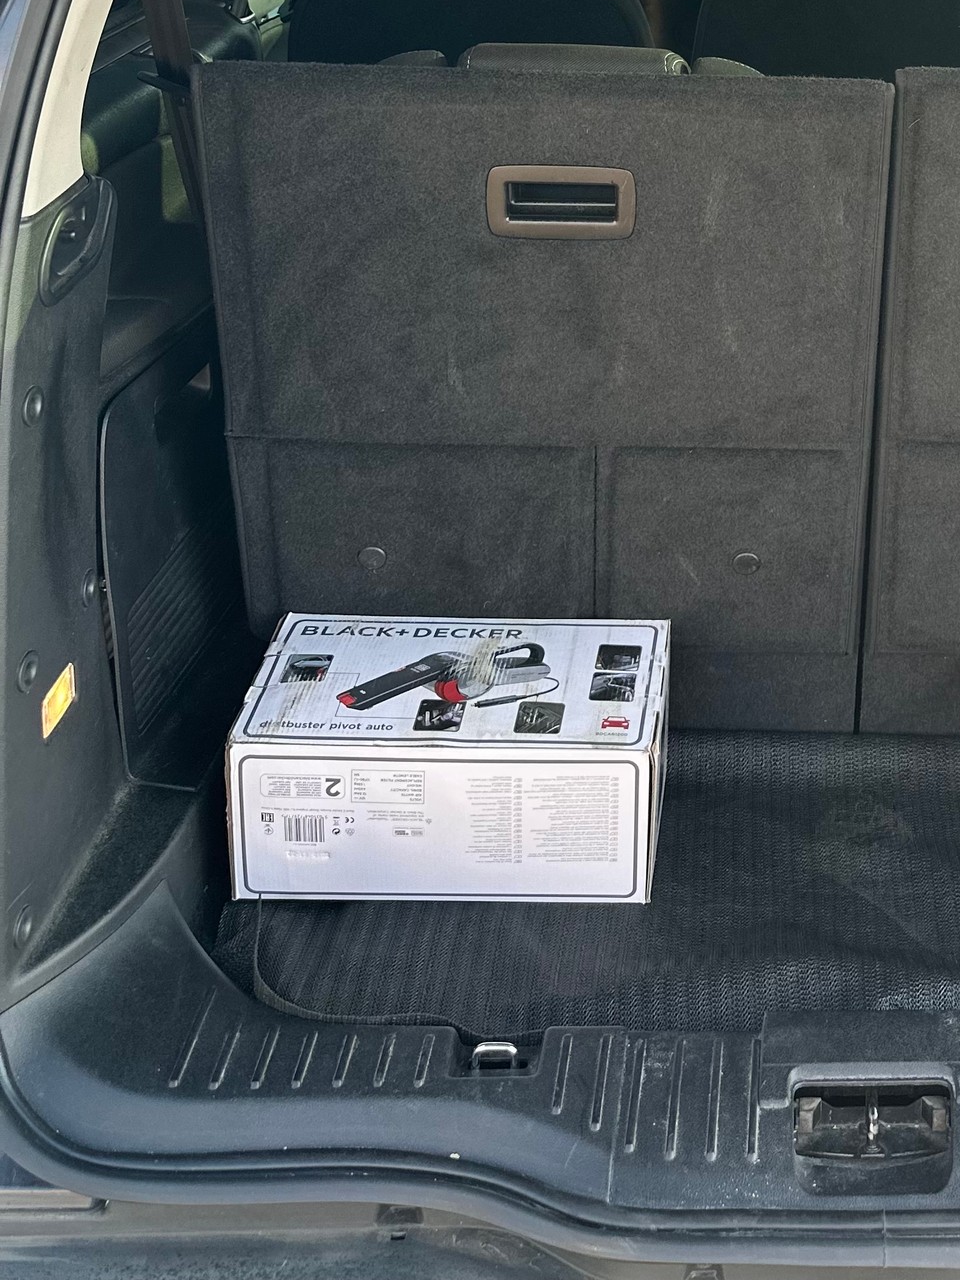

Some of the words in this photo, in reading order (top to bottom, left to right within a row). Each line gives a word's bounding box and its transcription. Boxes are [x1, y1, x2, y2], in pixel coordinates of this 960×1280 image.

[300, 625, 523, 639] BLACK+DECKER
[329, 721, 361, 730] pivot
[365, 723, 394, 731] auto
[325, 777, 341, 797] 2
